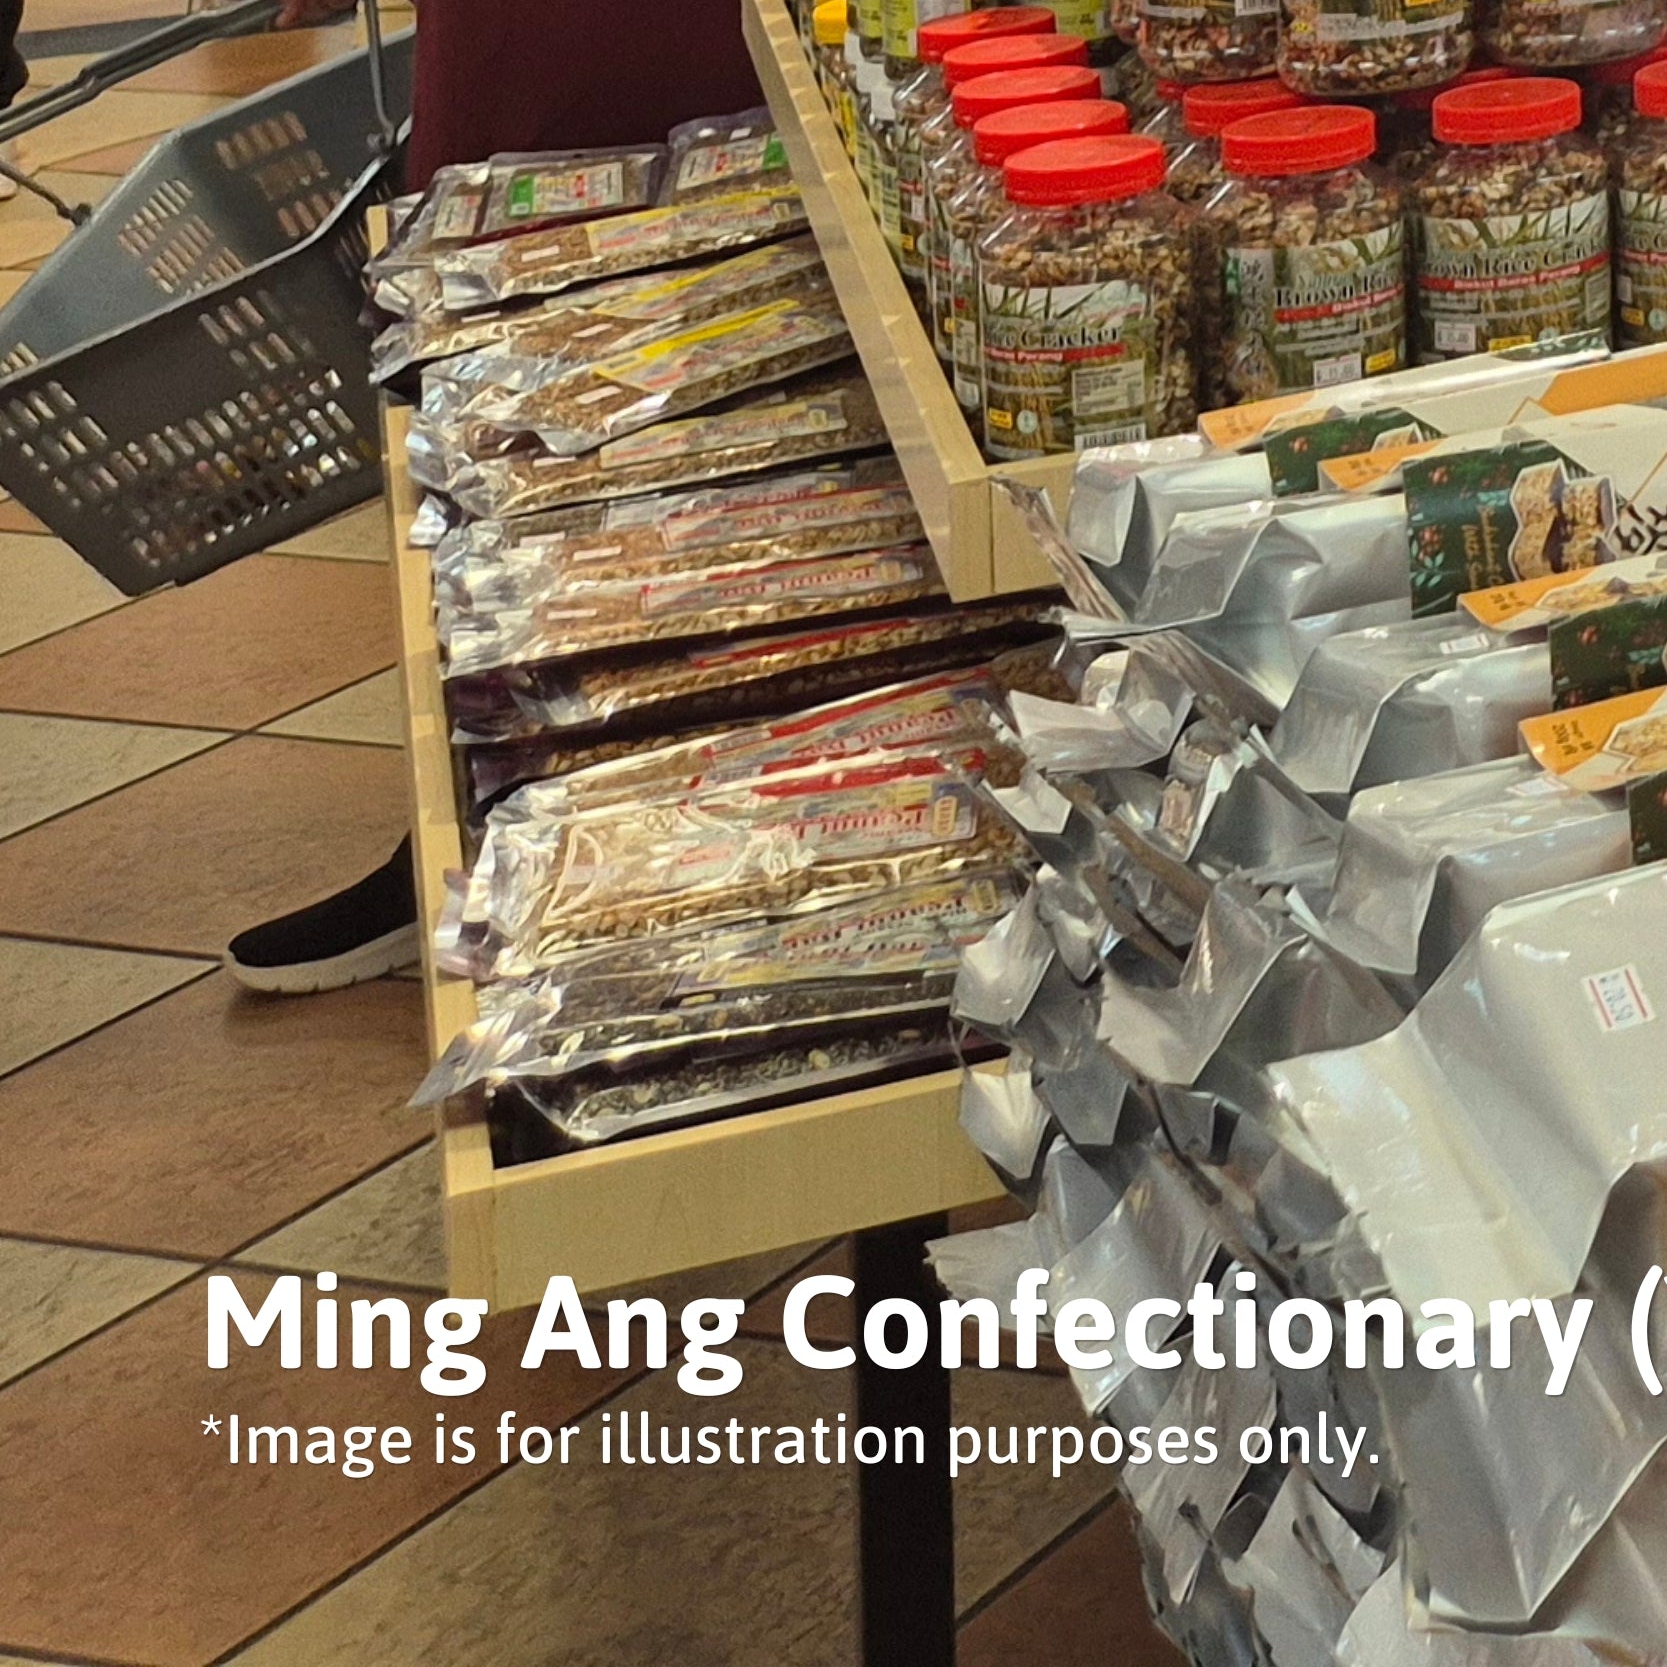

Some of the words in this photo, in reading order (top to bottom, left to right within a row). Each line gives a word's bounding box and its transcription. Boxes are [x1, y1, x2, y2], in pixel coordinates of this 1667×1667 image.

[1484, 255, 1536, 275] Rice
[1276, 285, 1354, 307] Brown
[1021, 325, 1121, 348] Cracker
